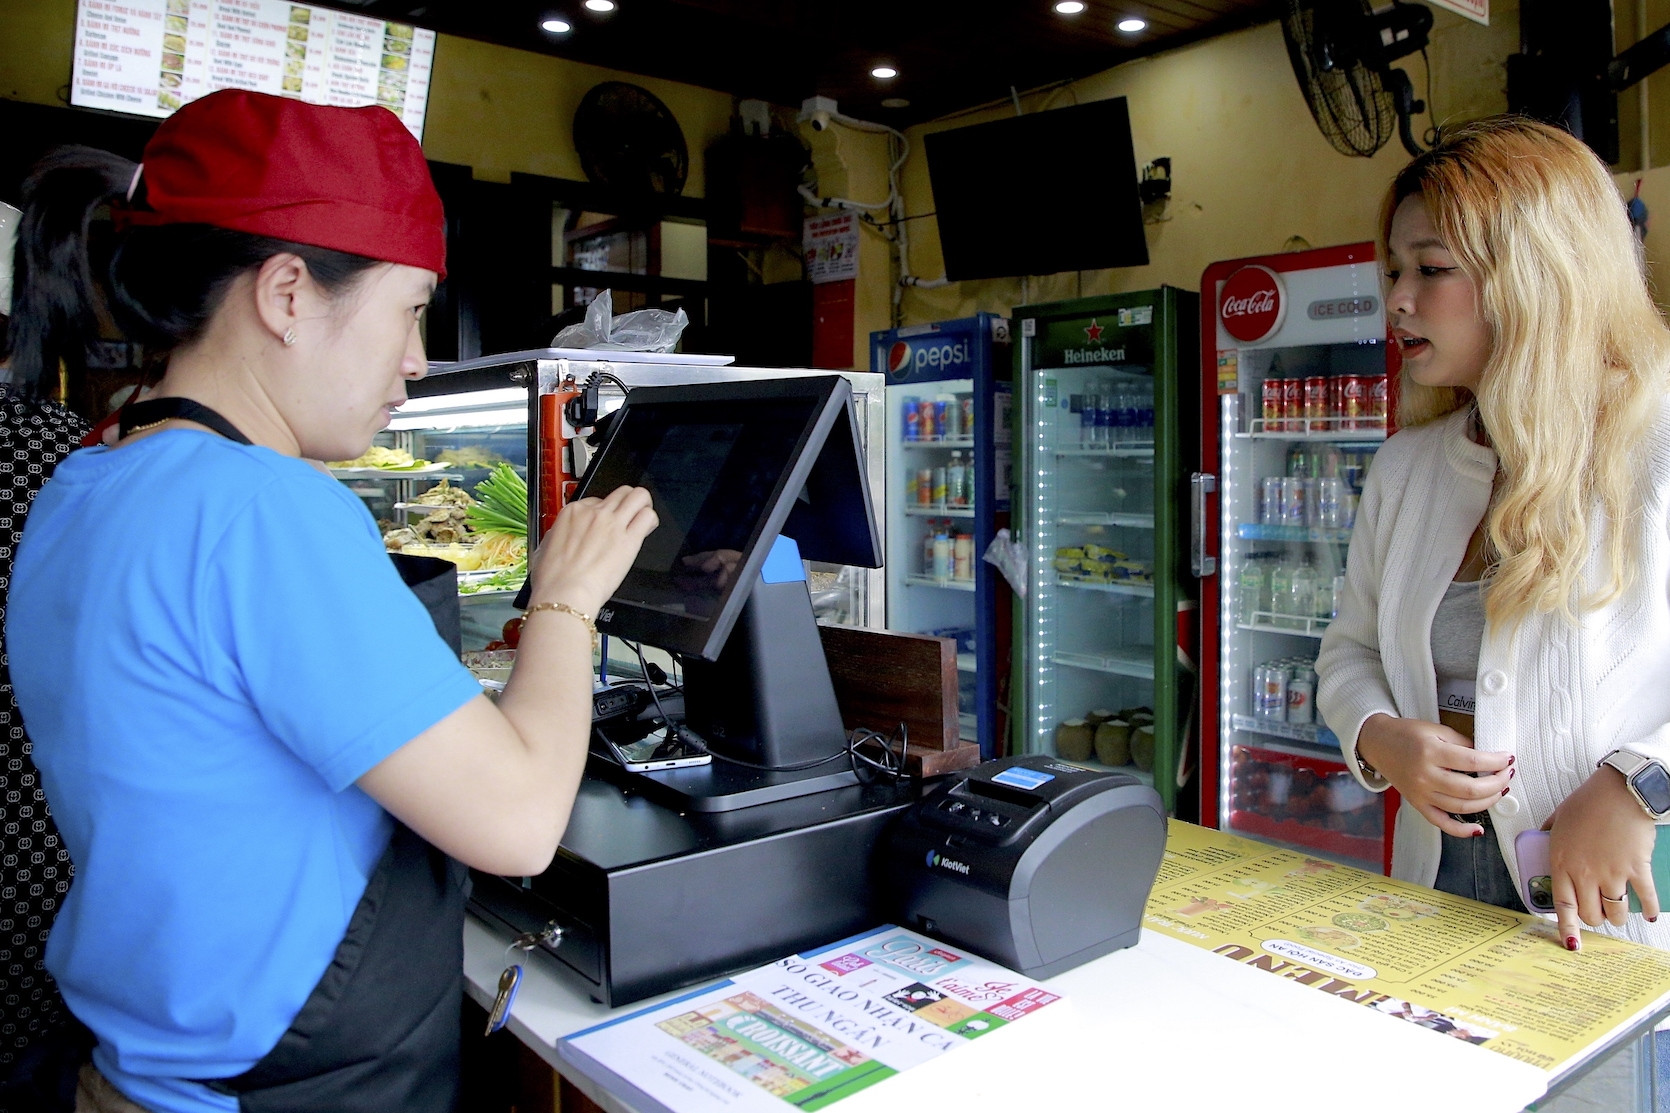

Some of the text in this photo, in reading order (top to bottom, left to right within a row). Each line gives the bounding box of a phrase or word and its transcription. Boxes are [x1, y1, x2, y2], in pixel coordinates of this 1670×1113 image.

[1222, 289, 1276, 319] Coca-Cola
[1314, 300, 1372, 316] ICE COLD
[915, 338, 970, 373] pepsi
[1064, 347, 1126, 364] Heineken
[941, 857, 970, 875] KiotViet
[865, 940, 949, 976] Paris
[1287, 950, 1308, 958] HỘI
[1309, 957, 1334, 966] SẢN
[1212, 944, 1378, 1003] MENU
[1336, 967, 1362, 976] ĐẶC
[771, 985, 818, 1012] THU
[822, 1010, 891, 1049] NGÂN
[804, 973, 859, 1001] GIAO
[856, 1000, 915, 1035] NHẬN
[920, 1032, 955, 1051] CA
[725, 1015, 844, 1079] CROISSANT
